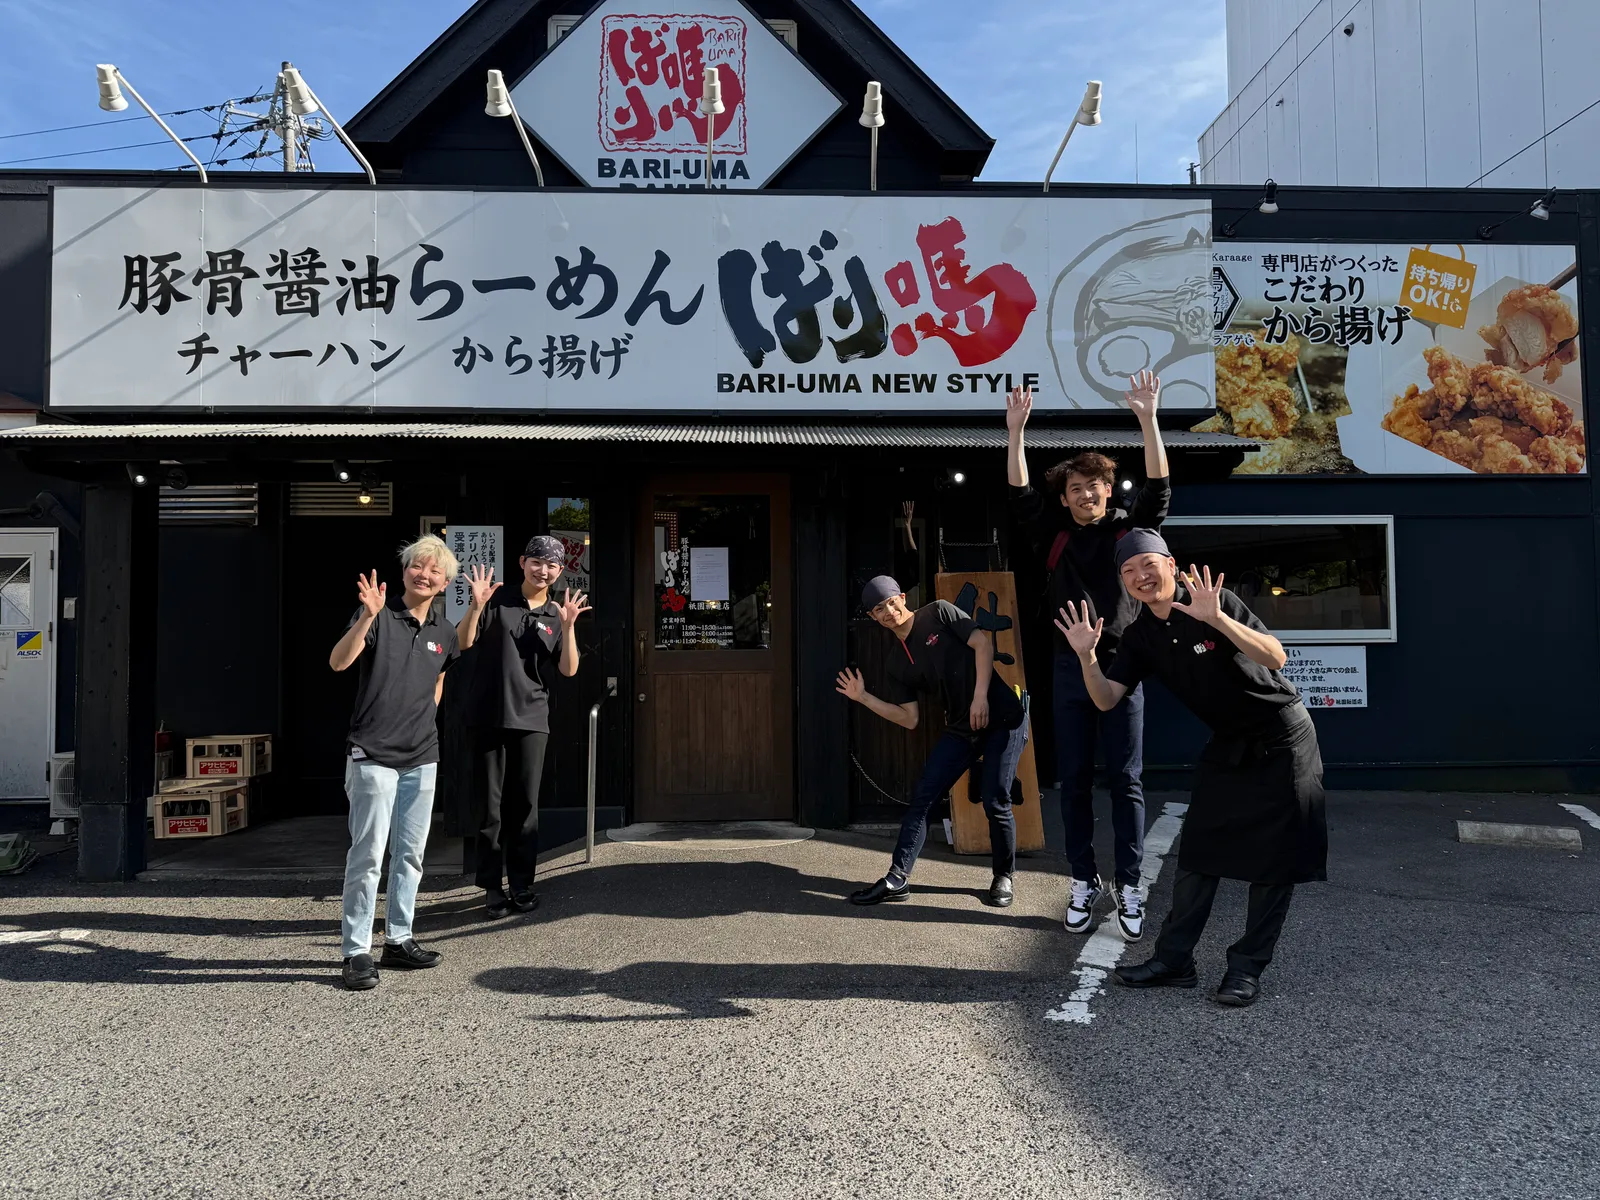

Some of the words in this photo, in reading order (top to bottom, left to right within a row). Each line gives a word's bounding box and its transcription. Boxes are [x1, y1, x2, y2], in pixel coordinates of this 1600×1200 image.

[704, 28, 737, 47] BARI
[708, 48, 736, 62] UMA
[597, 157, 751, 181] BARI-UMA
[1260, 253, 1399, 274] 専門店がつくった
[118, 243, 704, 328] 豚骨醤油らーめん
[1262, 274, 1366, 304] こだわり
[1408, 263, 1471, 294] 持ち帰り
[1409, 284, 1451, 311] OK!
[1258, 305, 1413, 347] から揚げ
[177, 332, 406, 377] チャーハン
[452, 331, 634, 381] から揚げ
[717, 373, 863, 394] BARI-UMA
[872, 373, 938, 394] NEW
[946, 373, 1040, 394] STYLE
[200, 761, 237, 769] アサヒビール
[169, 819, 207, 828] アサヒビール
